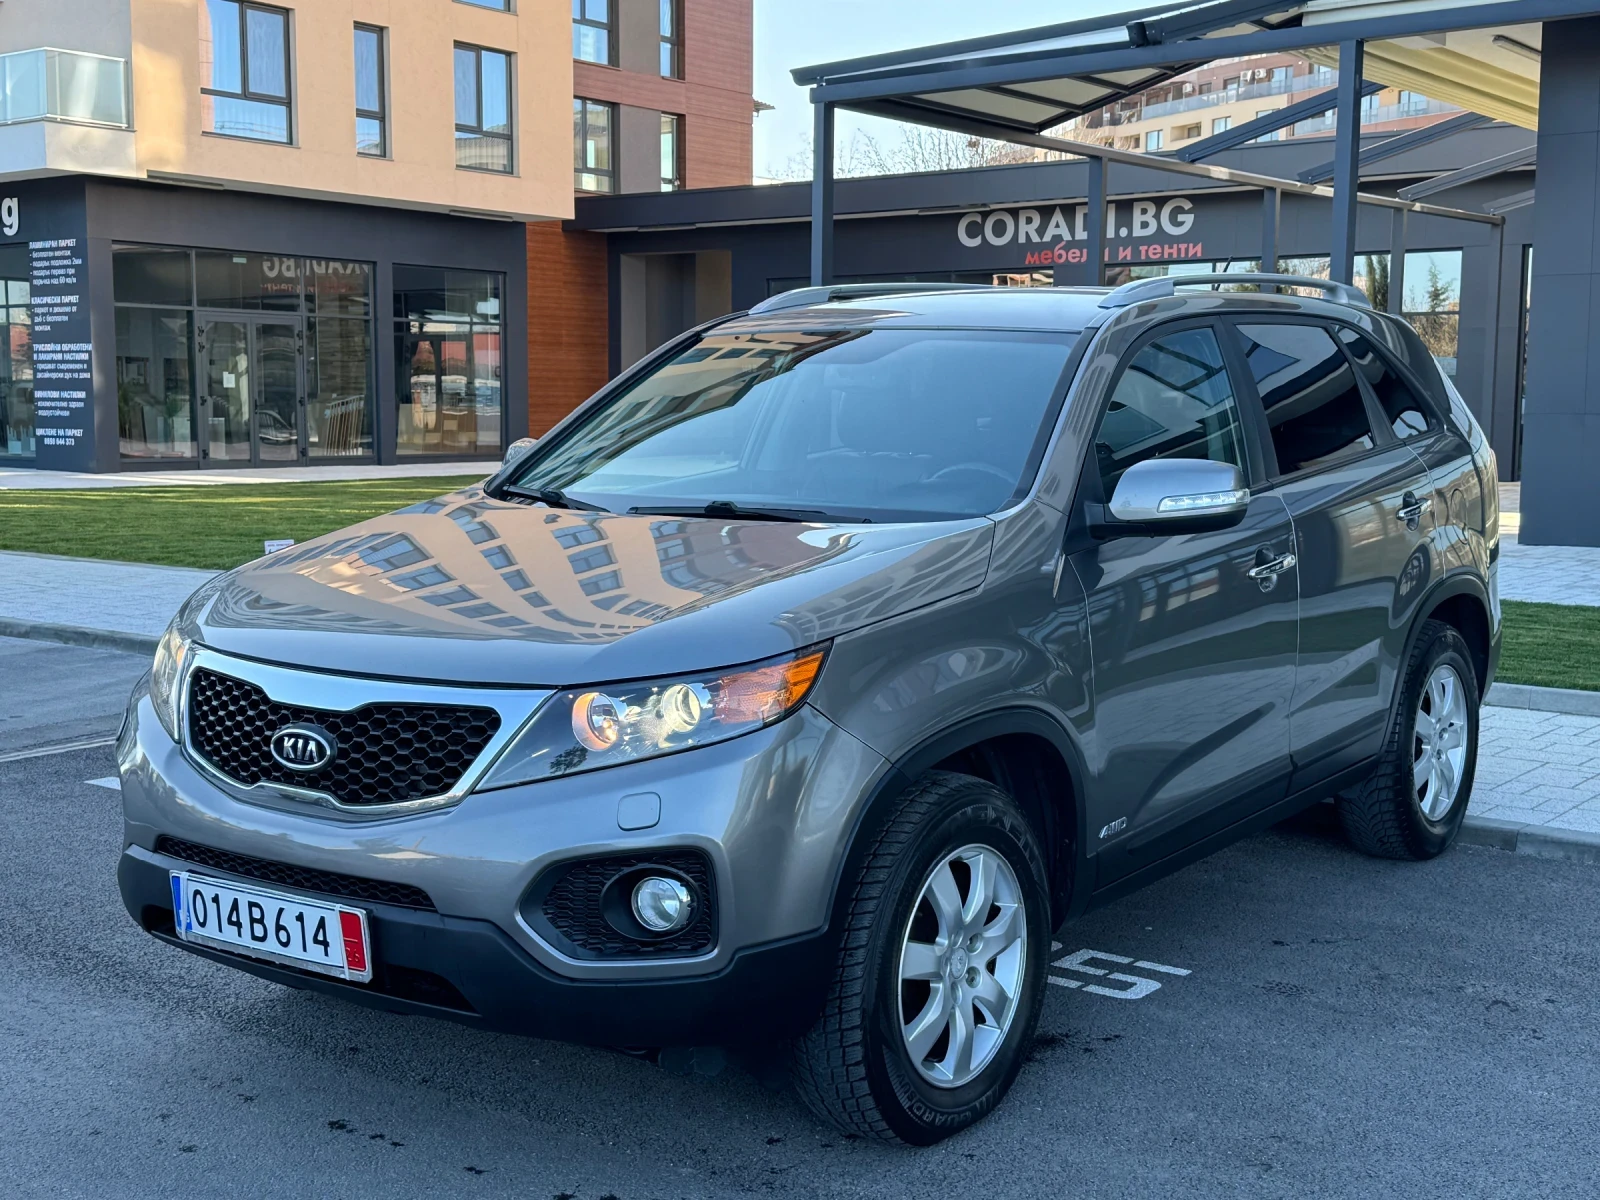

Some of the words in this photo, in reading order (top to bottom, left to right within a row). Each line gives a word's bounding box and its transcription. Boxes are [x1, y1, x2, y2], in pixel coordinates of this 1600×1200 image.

[58, 238, 76, 248] ПАРКЕТ
[1118, 246, 1131, 261] и
[1139, 242, 1202, 260] тенти
[31, 296, 61, 304] КЛАСИЧЕСКИ
[61, 295, 79, 303] ПАРКЕТ
[61, 343, 92, 351] ОБРАБОТЕНИ
[37, 352, 63, 361] ЛАКИРАНИ
[63, 352, 89, 361] НАСТИЛКИ
[60, 390, 87, 398] НАСТИЛКИ
[57, 428, 65, 436] НА
[64, 429, 84, 437] ПАРКЕТ
[283, 736, 318, 763] KIA
[192, 888, 330, 957] 014B614
